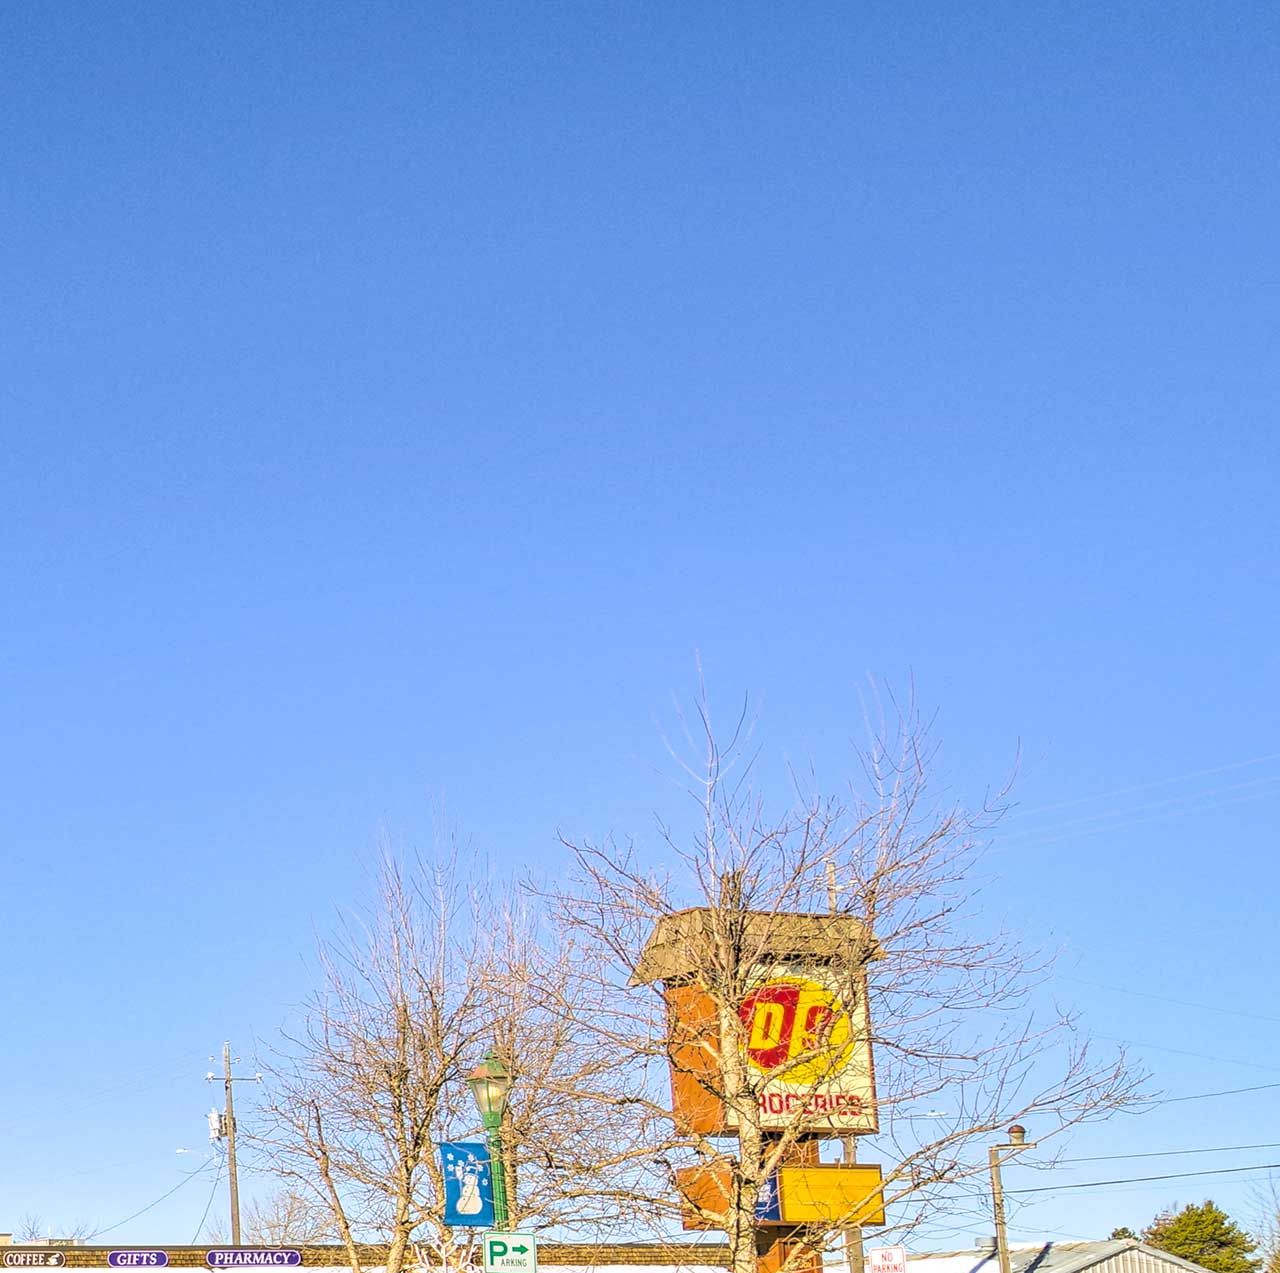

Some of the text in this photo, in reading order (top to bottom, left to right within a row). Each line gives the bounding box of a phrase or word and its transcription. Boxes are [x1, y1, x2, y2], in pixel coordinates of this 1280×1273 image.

[758, 1092, 863, 1117] ROCERIES
[6, 1254, 45, 1266] COFFEE
[116, 1253, 158, 1265] GIFTS
[214, 1252, 292, 1265] PHARMACY
[881, 1253, 893, 1261] NO
[873, 1263, 904, 1273] PARKING
